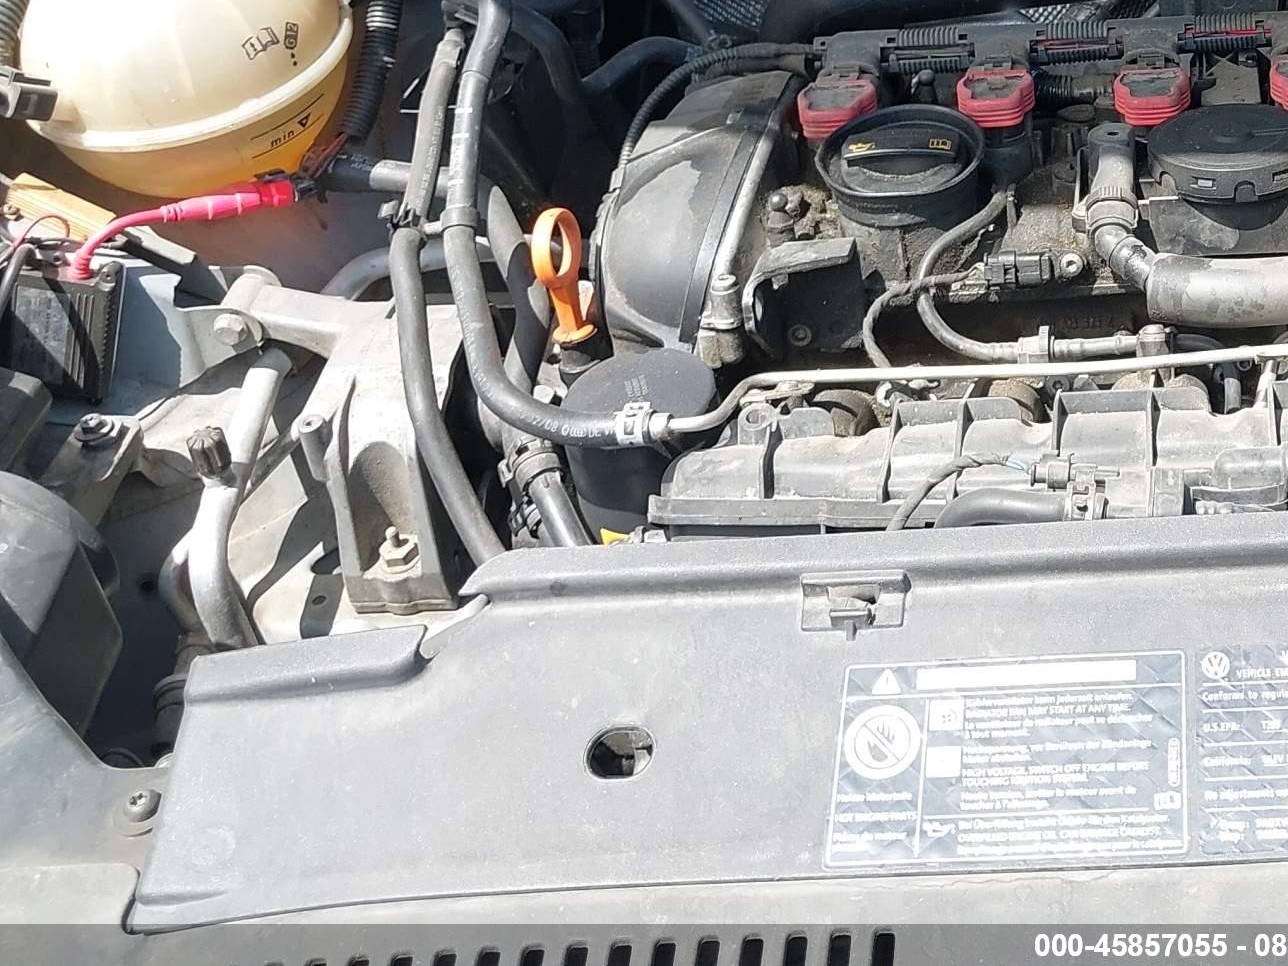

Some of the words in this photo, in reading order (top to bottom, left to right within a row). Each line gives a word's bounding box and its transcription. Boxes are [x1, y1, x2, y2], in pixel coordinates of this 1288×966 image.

[270, 129, 295, 148] min
[1236, 667, 1272, 680] VEHICLE
[1202, 689, 1245, 702] Conforms
[1247, 688, 1257, 699] to
[1049, 705, 1075, 715] START
[1075, 704, 1086, 713] AT
[1087, 703, 1105, 713] ANY
[1064, 764, 1082, 773] OFF
